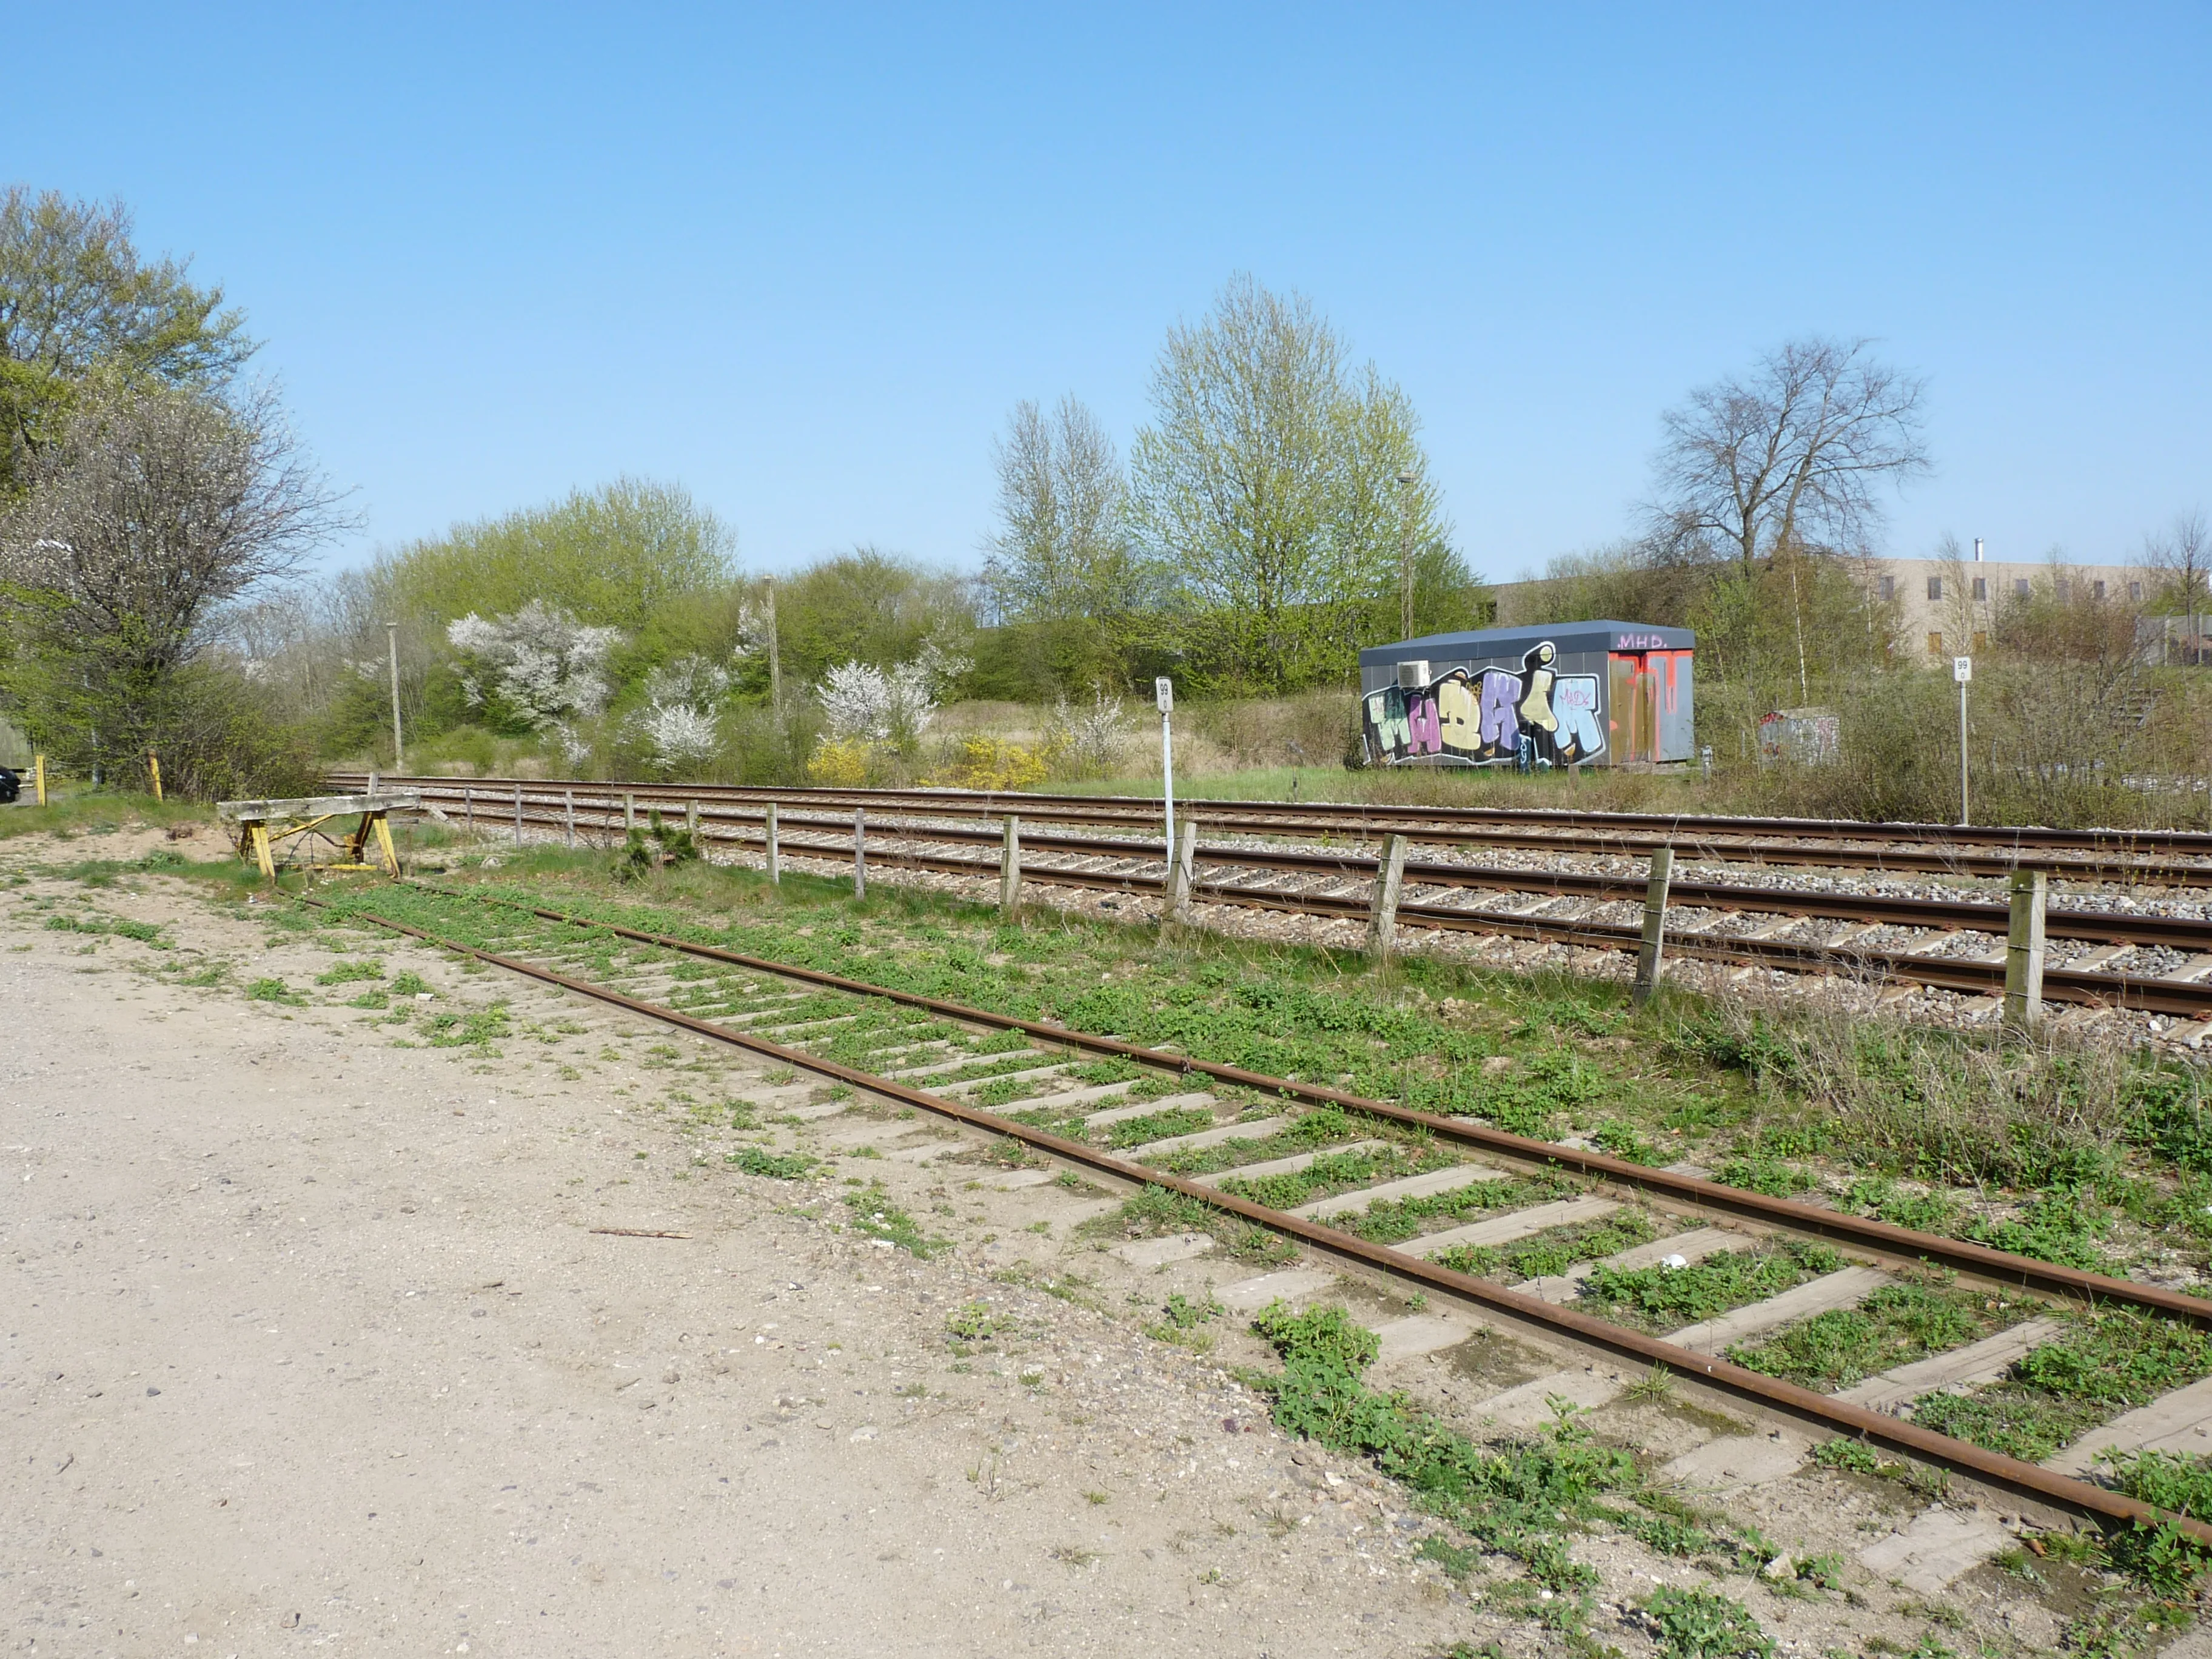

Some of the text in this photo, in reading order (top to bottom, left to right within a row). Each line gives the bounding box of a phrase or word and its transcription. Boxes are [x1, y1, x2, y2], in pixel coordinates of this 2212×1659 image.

[1958, 661, 1968, 669] 99
[1160, 683, 1168, 695] 99
[1164, 700, 1167, 709] 0
